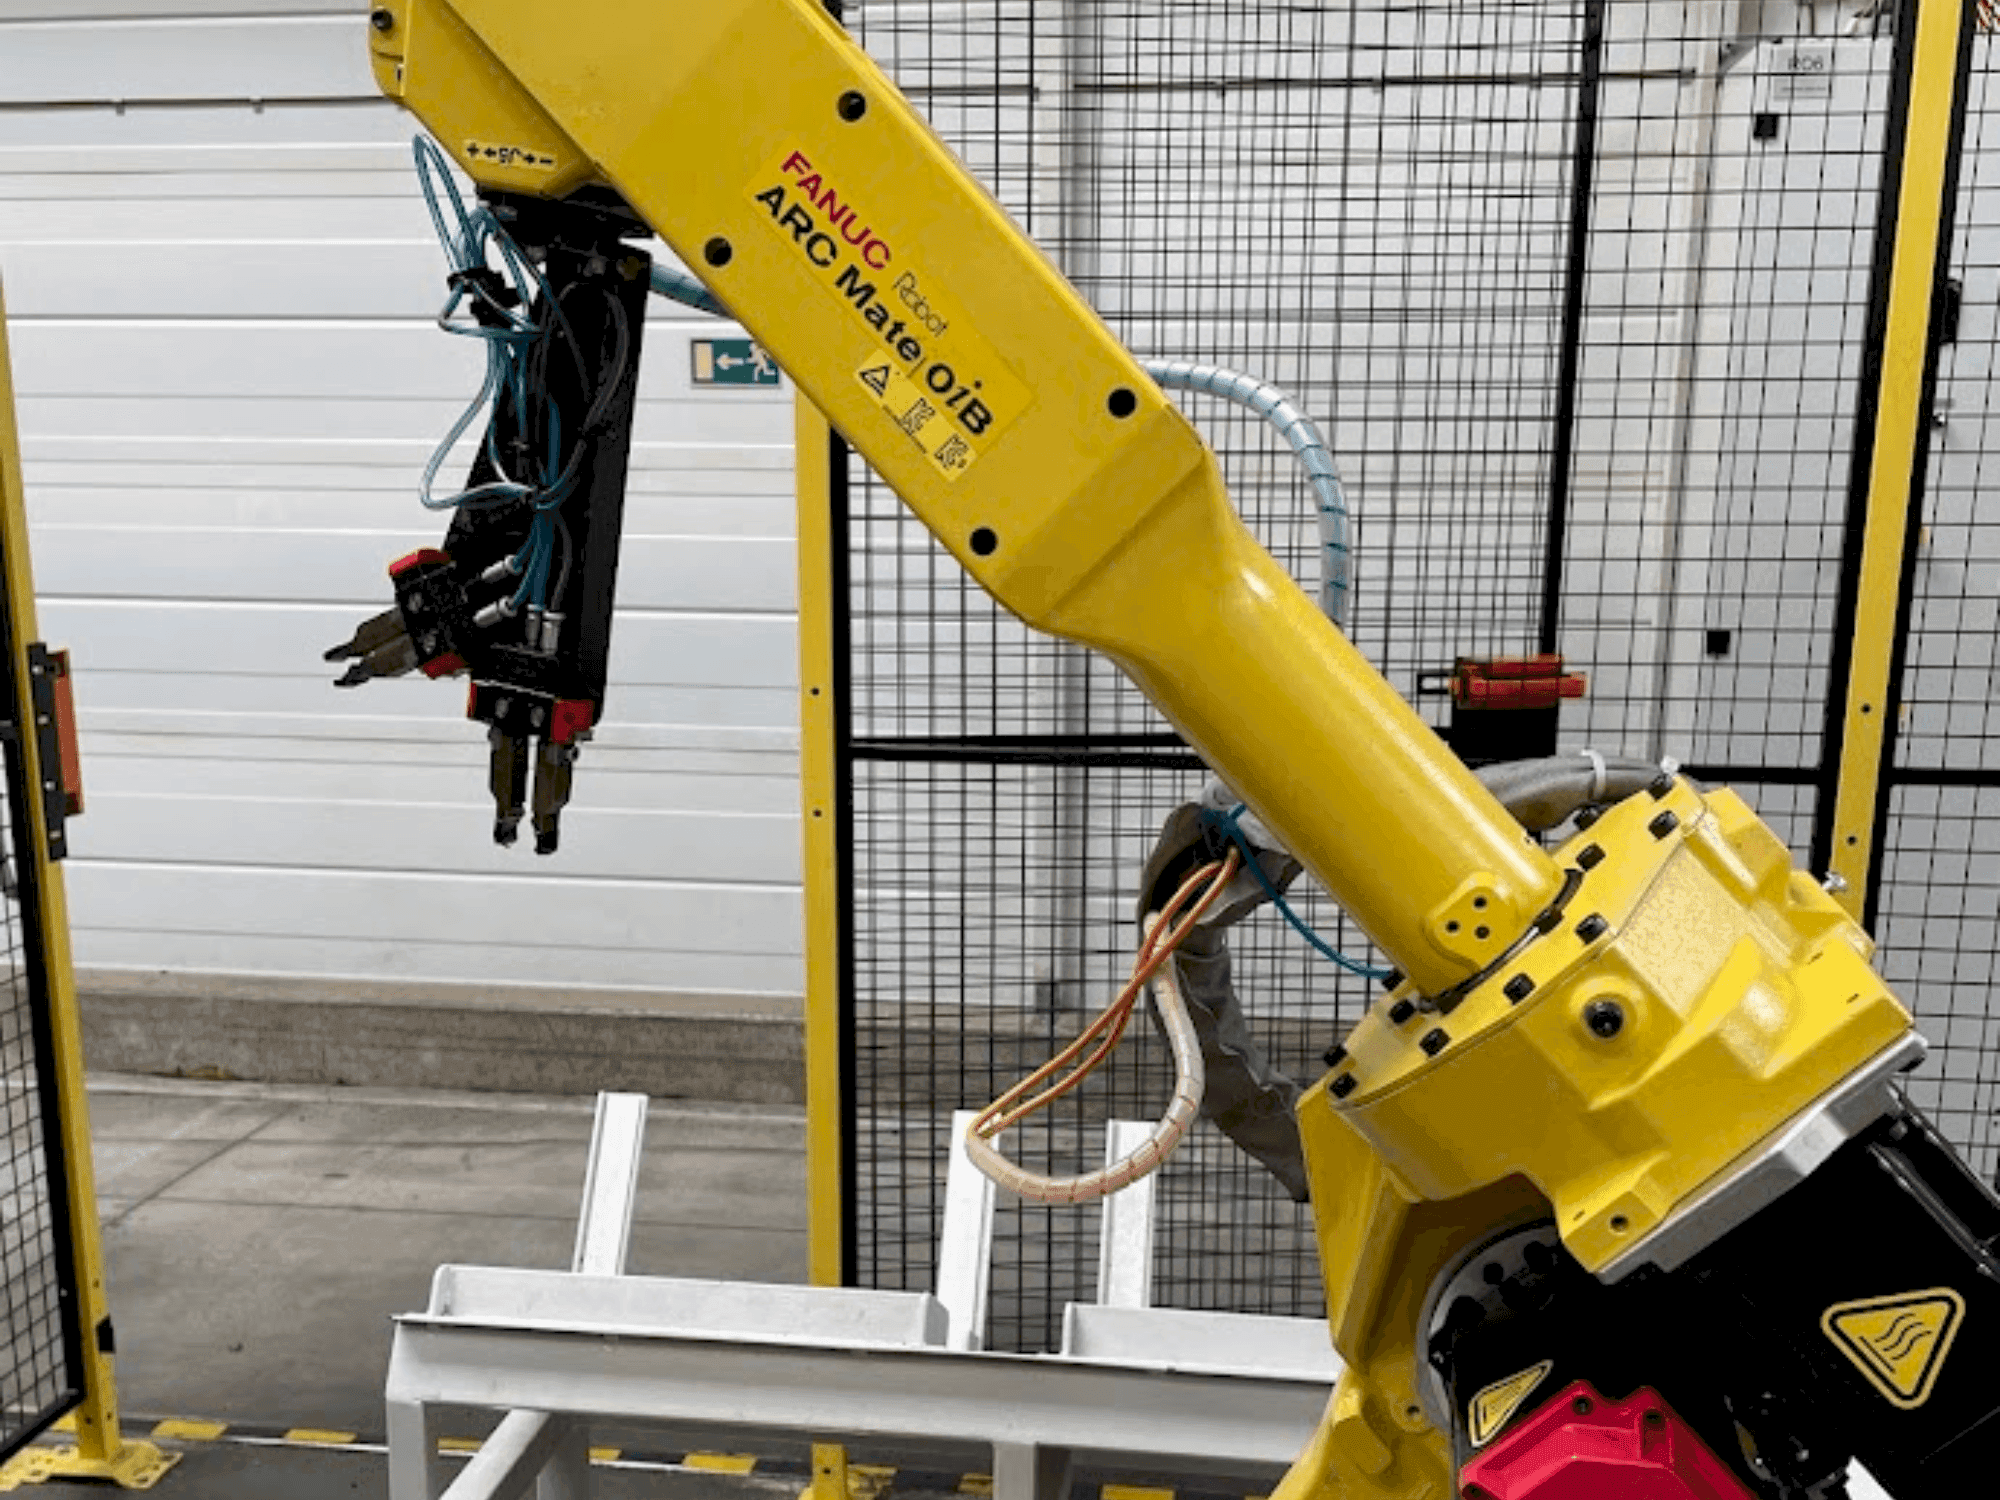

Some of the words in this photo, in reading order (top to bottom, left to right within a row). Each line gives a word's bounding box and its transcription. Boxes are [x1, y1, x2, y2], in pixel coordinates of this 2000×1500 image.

[755, 186, 837, 268] ARC
[835, 264, 921, 361] Mate
[781, 151, 890, 270] FANUC
[891, 270, 948, 338] Robot
